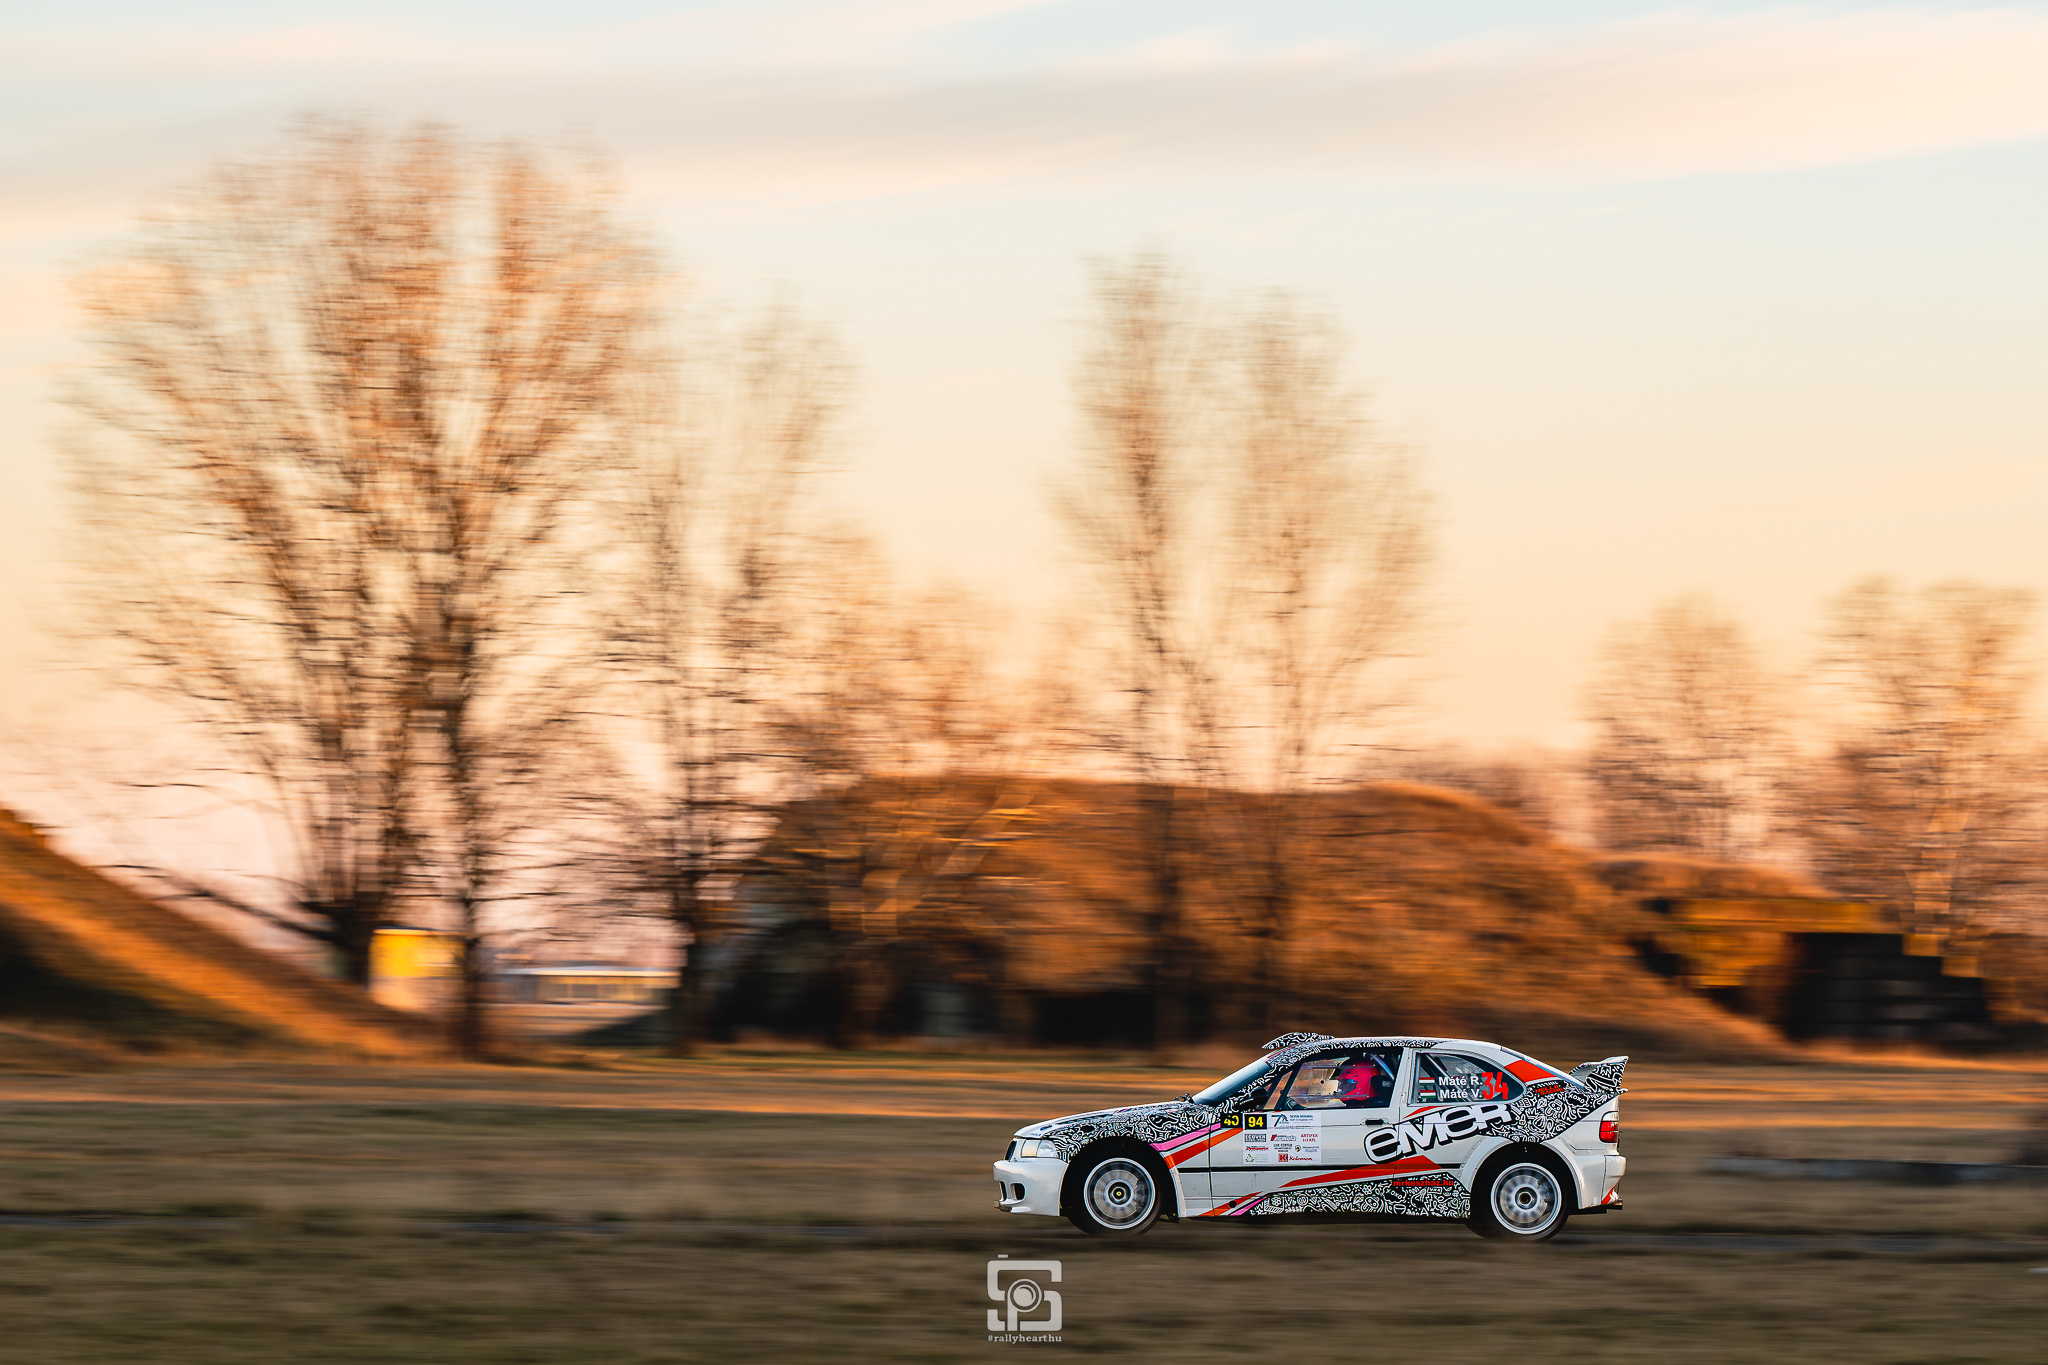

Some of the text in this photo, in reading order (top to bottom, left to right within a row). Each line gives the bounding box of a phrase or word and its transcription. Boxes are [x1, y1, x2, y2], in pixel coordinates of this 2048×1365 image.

[1438, 1075, 1483, 1086] Máté R.
[1481, 1071, 1509, 1100] 34
[1440, 1088, 1483, 1099] Máté V.
[1248, 1116, 1264, 1127] 94
[1393, 1179, 1454, 1187] mrkeszhaz.hu
